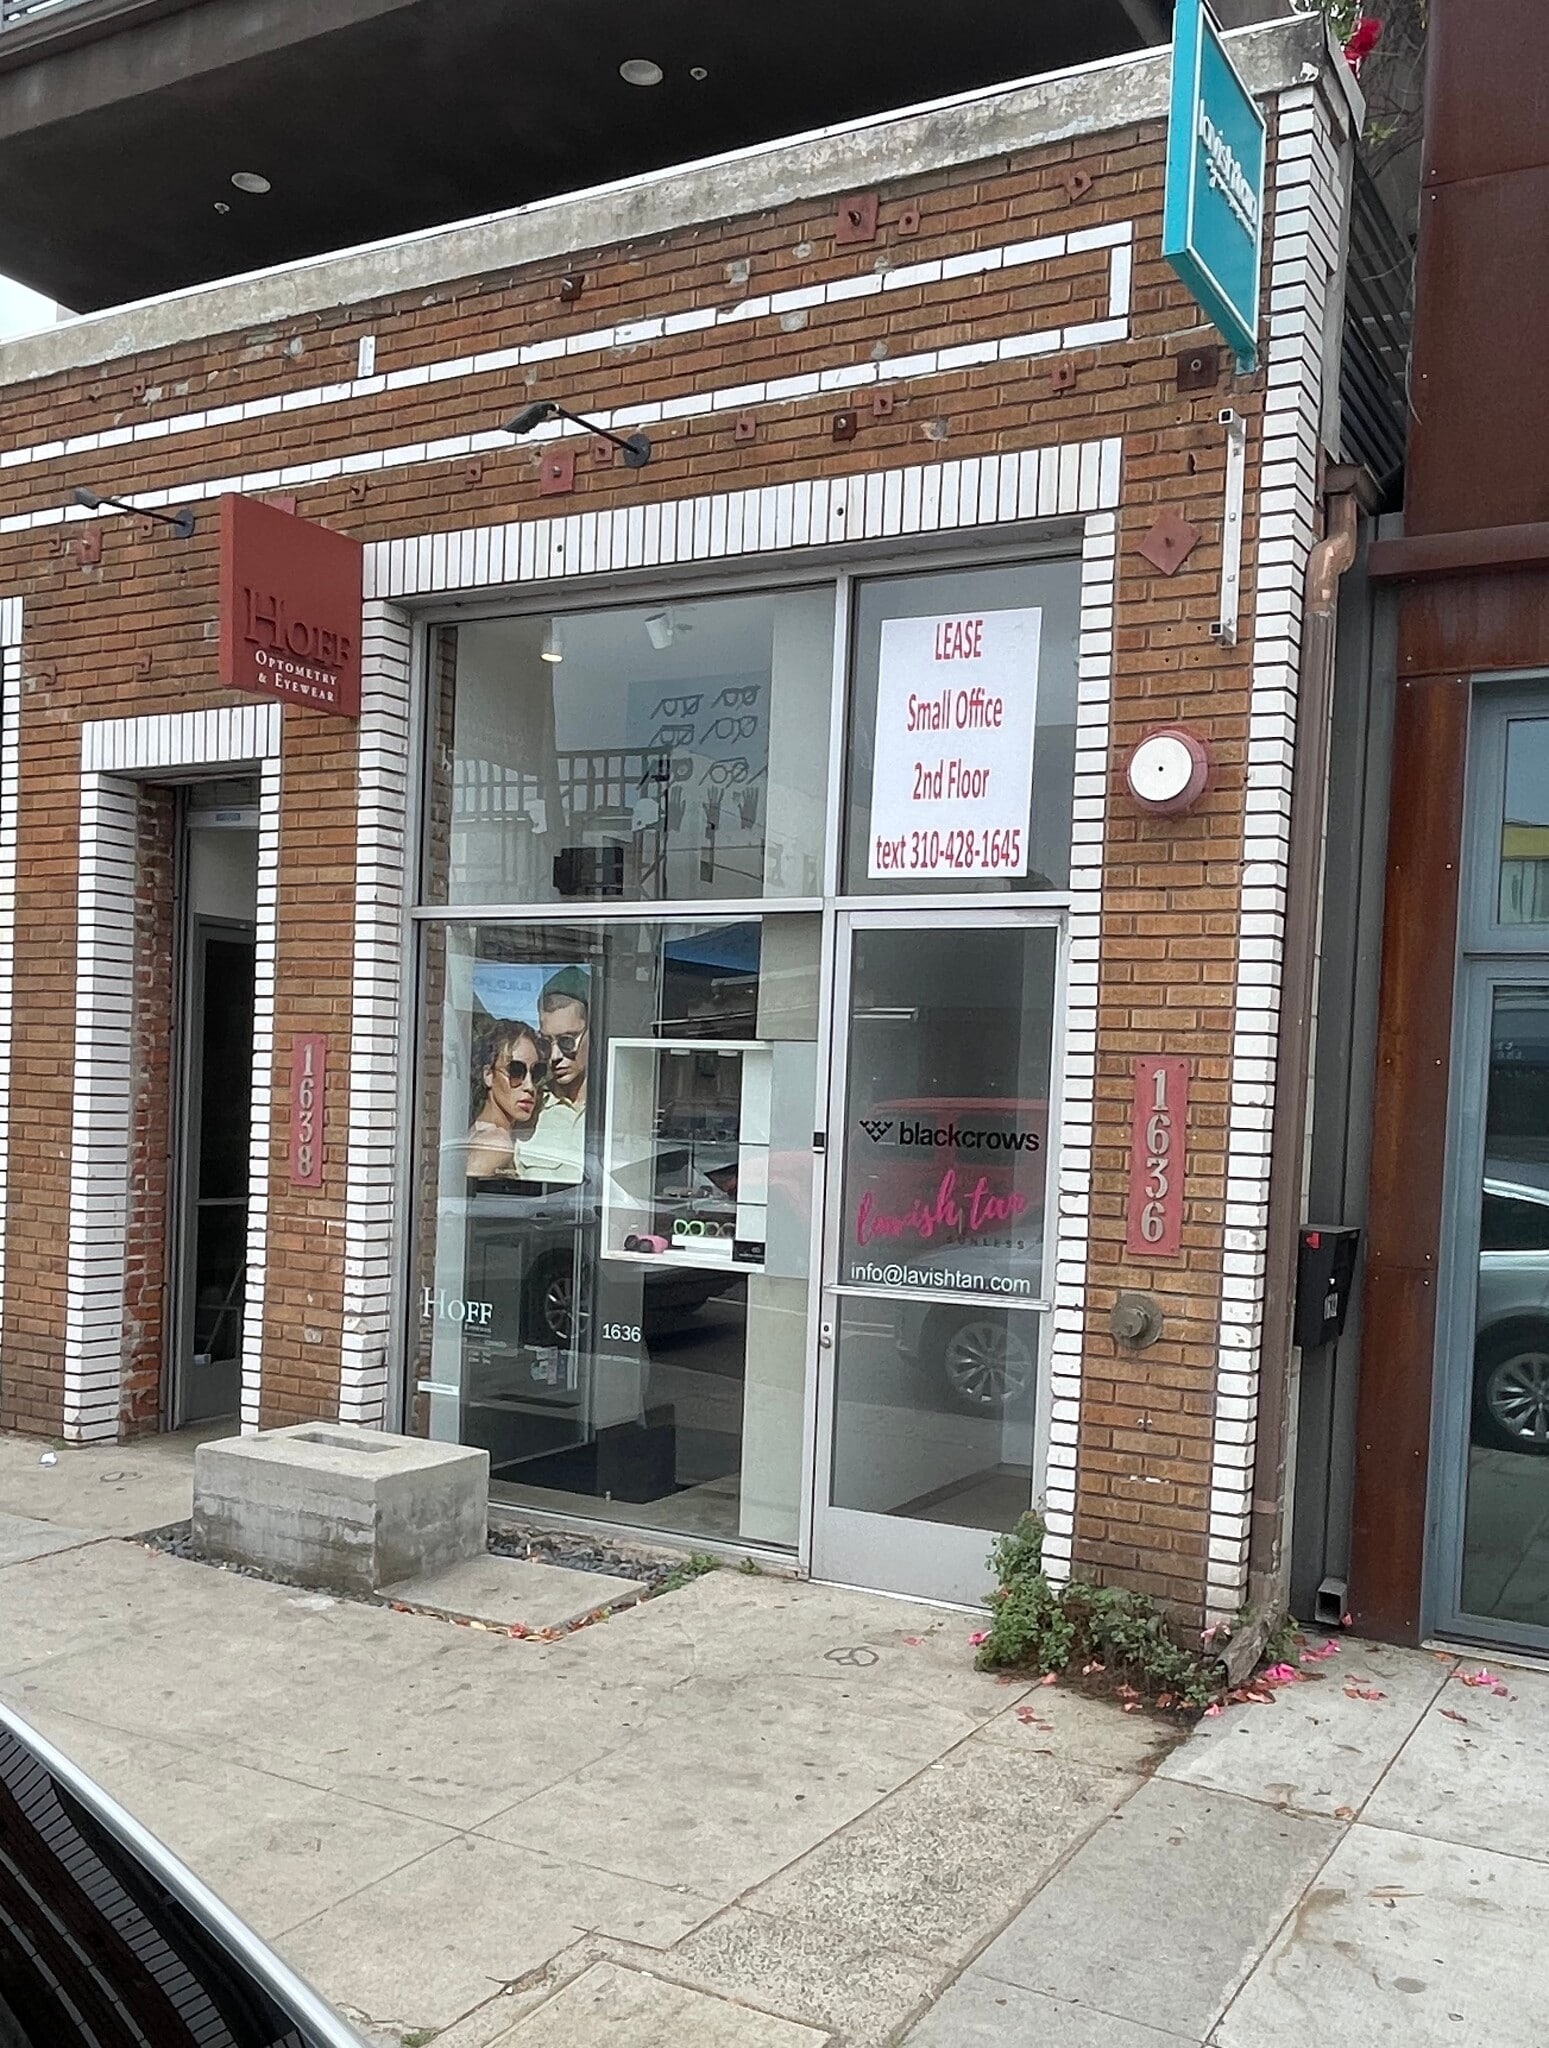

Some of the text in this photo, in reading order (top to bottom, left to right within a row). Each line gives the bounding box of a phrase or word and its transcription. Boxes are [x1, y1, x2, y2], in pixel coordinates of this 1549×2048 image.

[243, 587, 350, 669] HOFF
[935, 620, 983, 660] LEASE
[255, 650, 337, 686] OPTOMETRY
[258, 672, 335, 702] & EYEWEAR
[907, 687, 1003, 731] Small Office
[912, 758, 990, 800] 2nd Floor
[876, 829, 1021, 869] text 310-428-1645
[297, 1043, 314, 1177] 1638
[900, 1121, 1040, 1151] blackcrows
[1141, 1069, 1171, 1243] 1636
[851, 1262, 1030, 1294] info@lavishtan.com
[422, 1286, 493, 1325] HOFF
[602, 1323, 642, 1343] 1636
